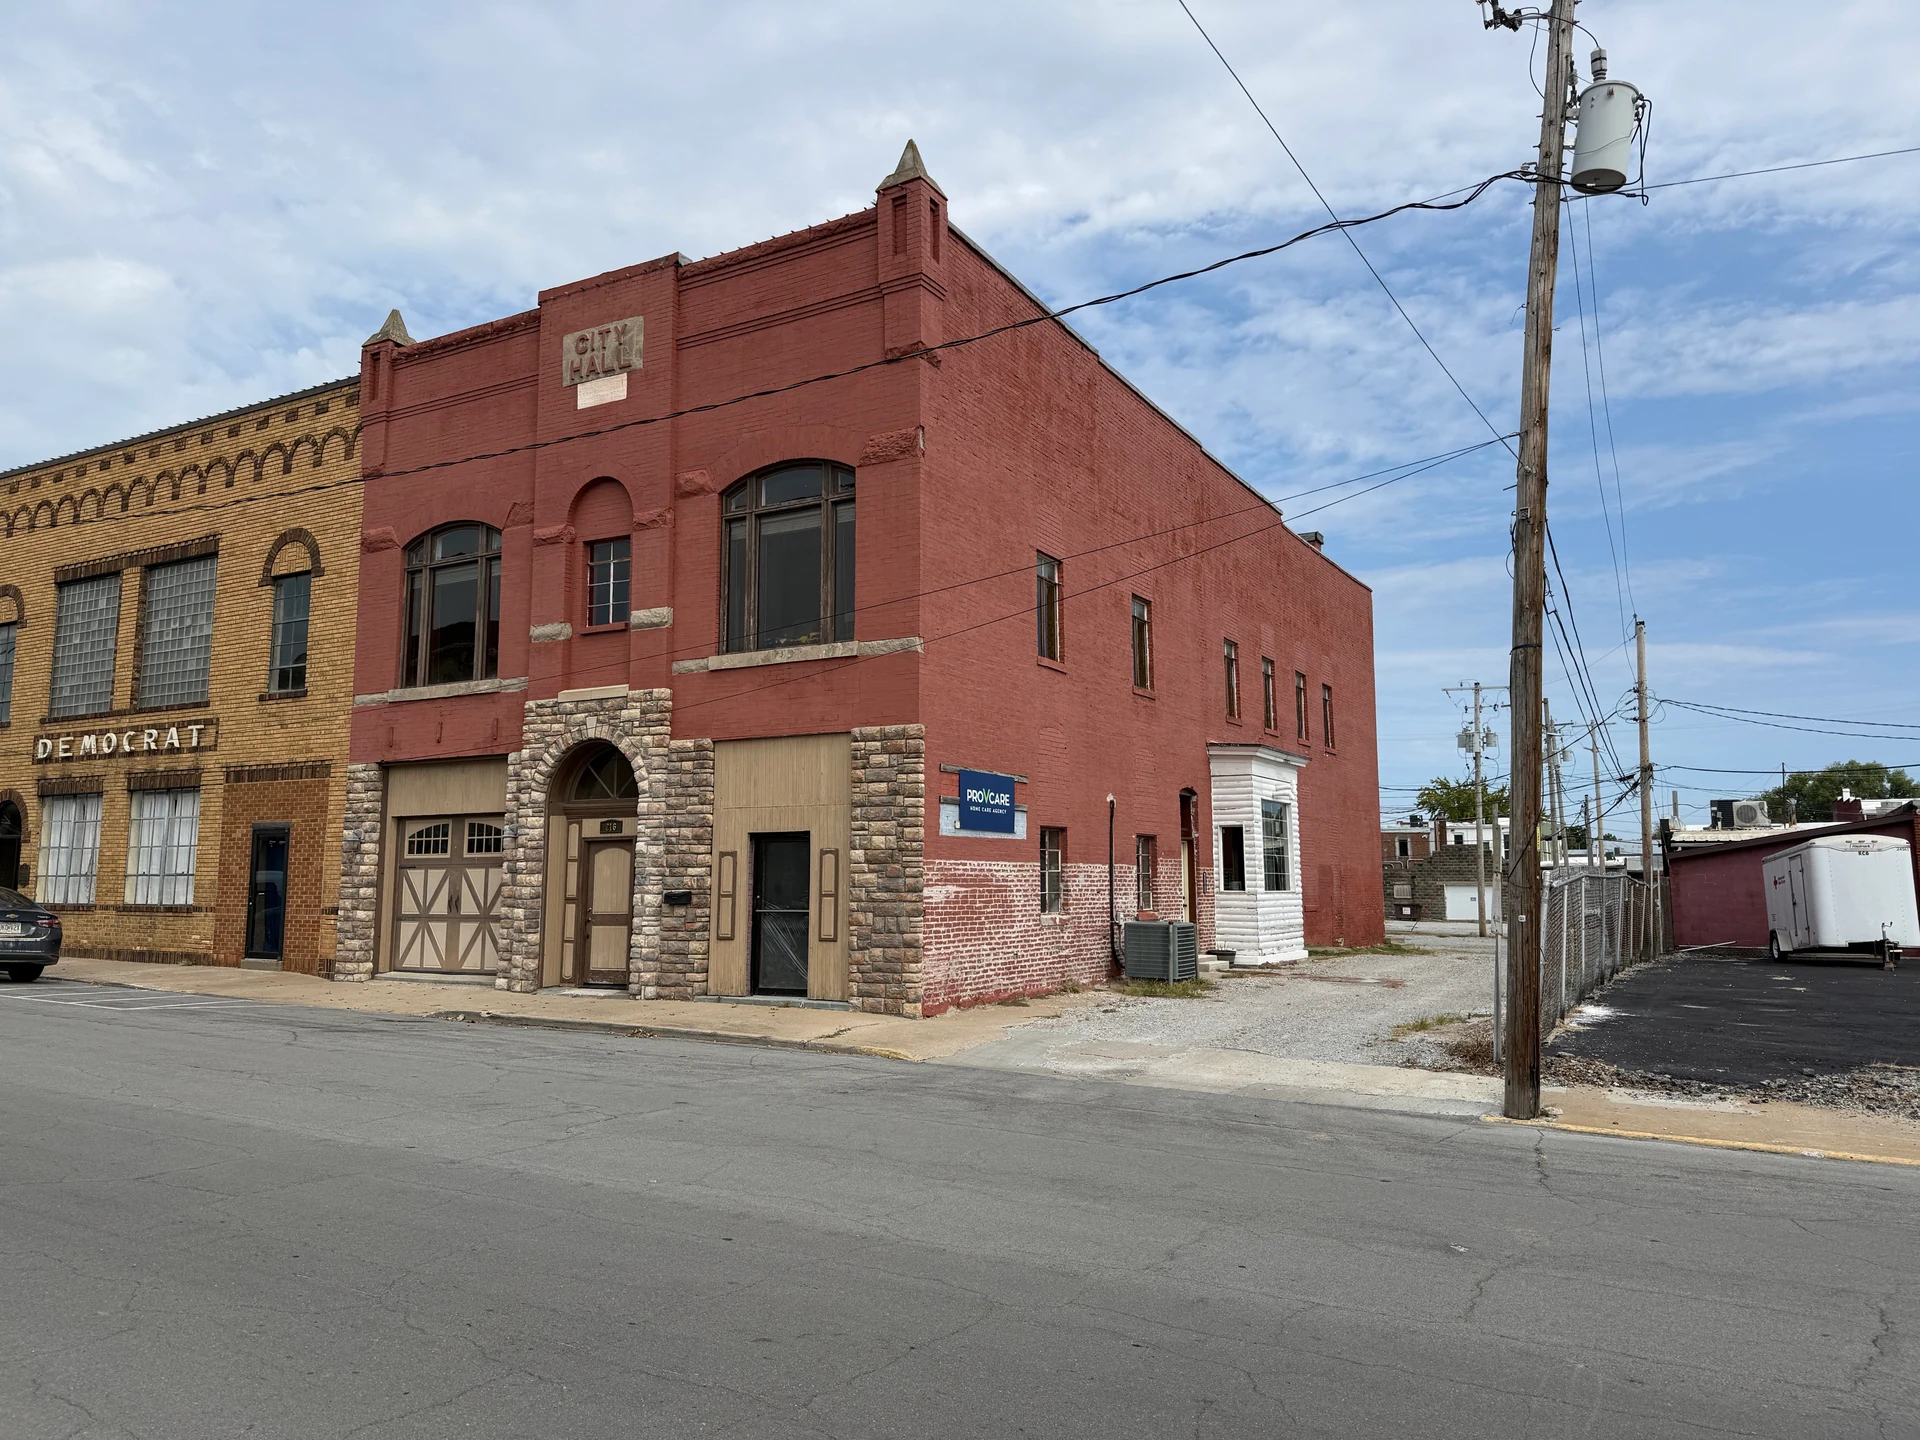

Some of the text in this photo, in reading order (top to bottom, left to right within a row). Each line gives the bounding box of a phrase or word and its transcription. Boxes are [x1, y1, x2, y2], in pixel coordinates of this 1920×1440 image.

[575, 324, 628, 355] CITY
[569, 345, 632, 381] HALL
[37, 725, 204, 759] DEMOCRAT
[967, 788, 1010, 806] PROVCARE
[605, 822, 617, 831] 216
